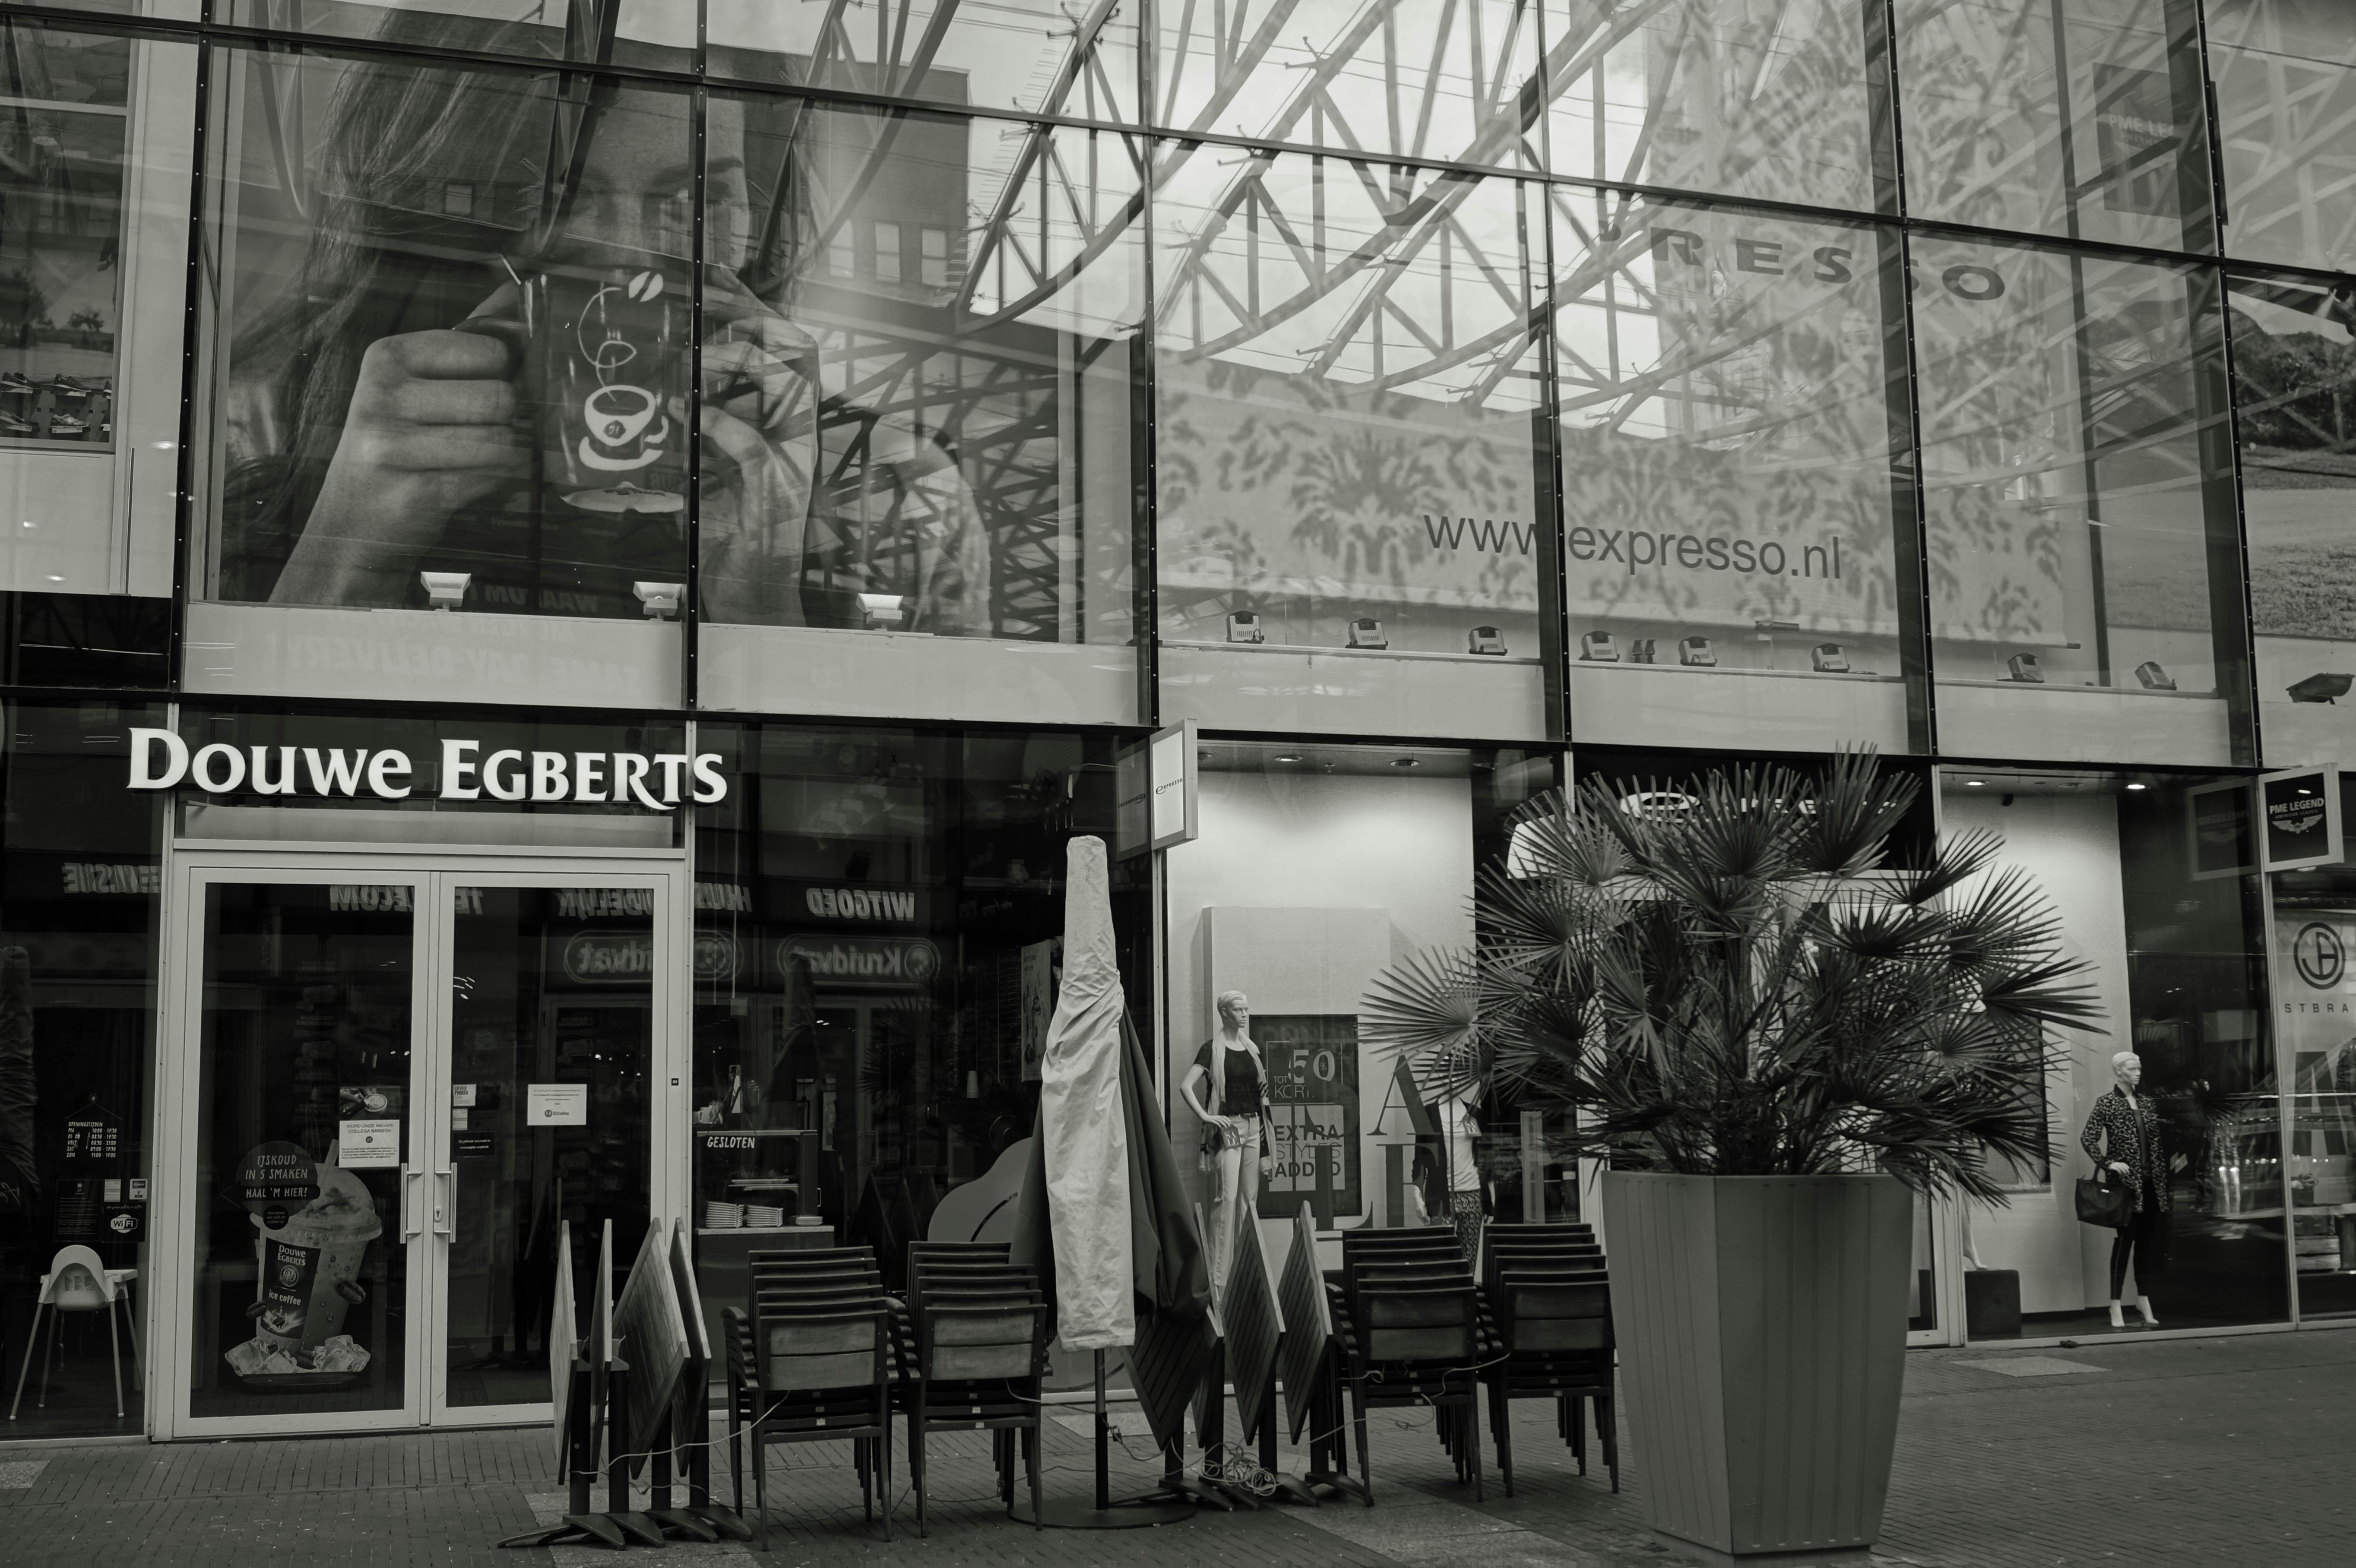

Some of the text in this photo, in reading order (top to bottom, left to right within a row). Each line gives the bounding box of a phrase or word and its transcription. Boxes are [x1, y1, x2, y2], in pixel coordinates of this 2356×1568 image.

[1423, 514, 1841, 579] wwwexpresso.nl
[439, 739, 727, 810] EGBERTS
[2269, 797, 2324, 815] PME LEGEND
[1273, 1075, 1288, 1084] TOT
[1274, 1125, 1339, 1141] EXTRA
[707, 1136, 755, 1149] GESLOTEN
[1275, 1142, 1341, 1160] STYLS
[257, 1155, 297, 1167] IJSKOUD
[245, 1168, 307, 1180] IN 5 SMAKEN
[1275, 1162, 1341, 1178] ADDD
[246, 1188, 266, 1198] HAAL
[284, 1187, 307, 1197] HIER!
[277, 1252, 306, 1266] EGBERTS
[269, 1289, 301, 1306] ice coffee
